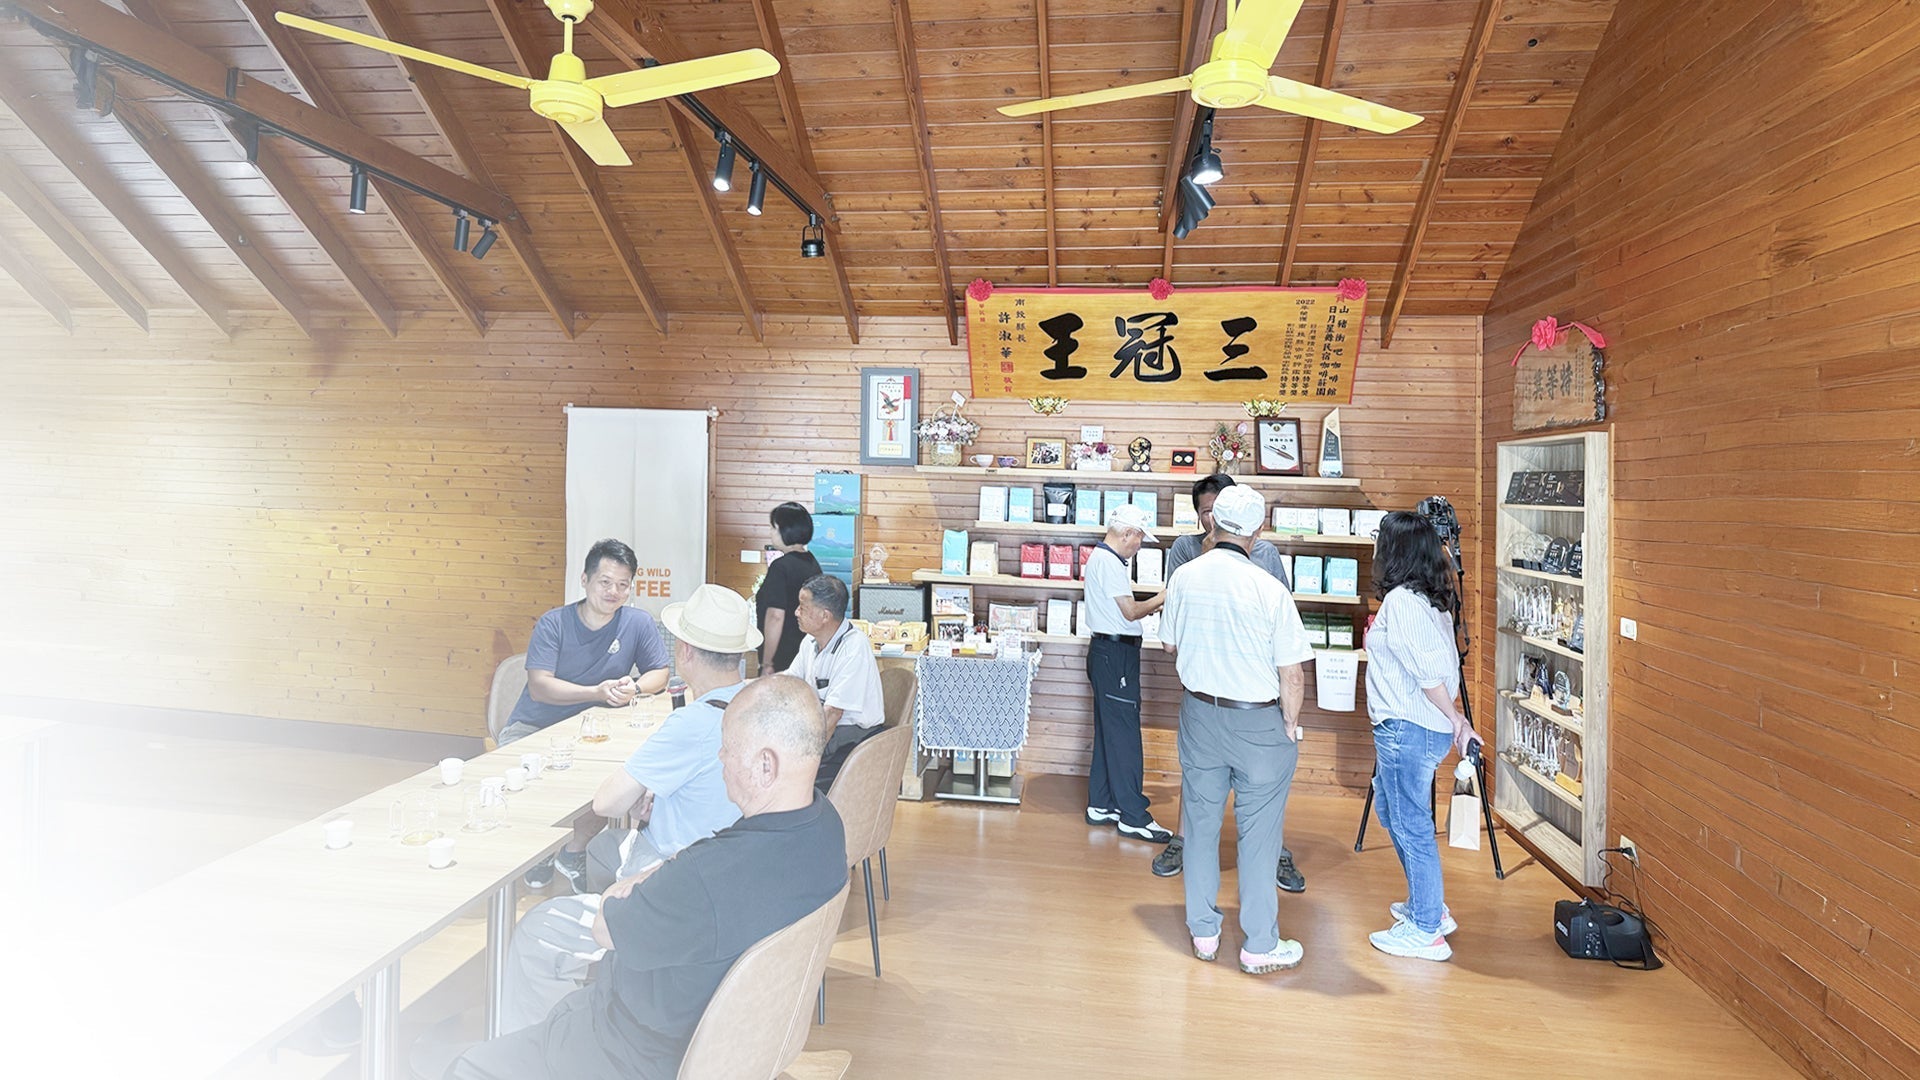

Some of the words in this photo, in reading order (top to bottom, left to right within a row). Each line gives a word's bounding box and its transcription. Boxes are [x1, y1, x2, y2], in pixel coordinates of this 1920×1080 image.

[998, 311, 1013, 359] 許淑華
[1015, 298, 1026, 343] 南投縣長
[646, 568, 671, 577] WILD
[636, 580, 671, 597] FEE
